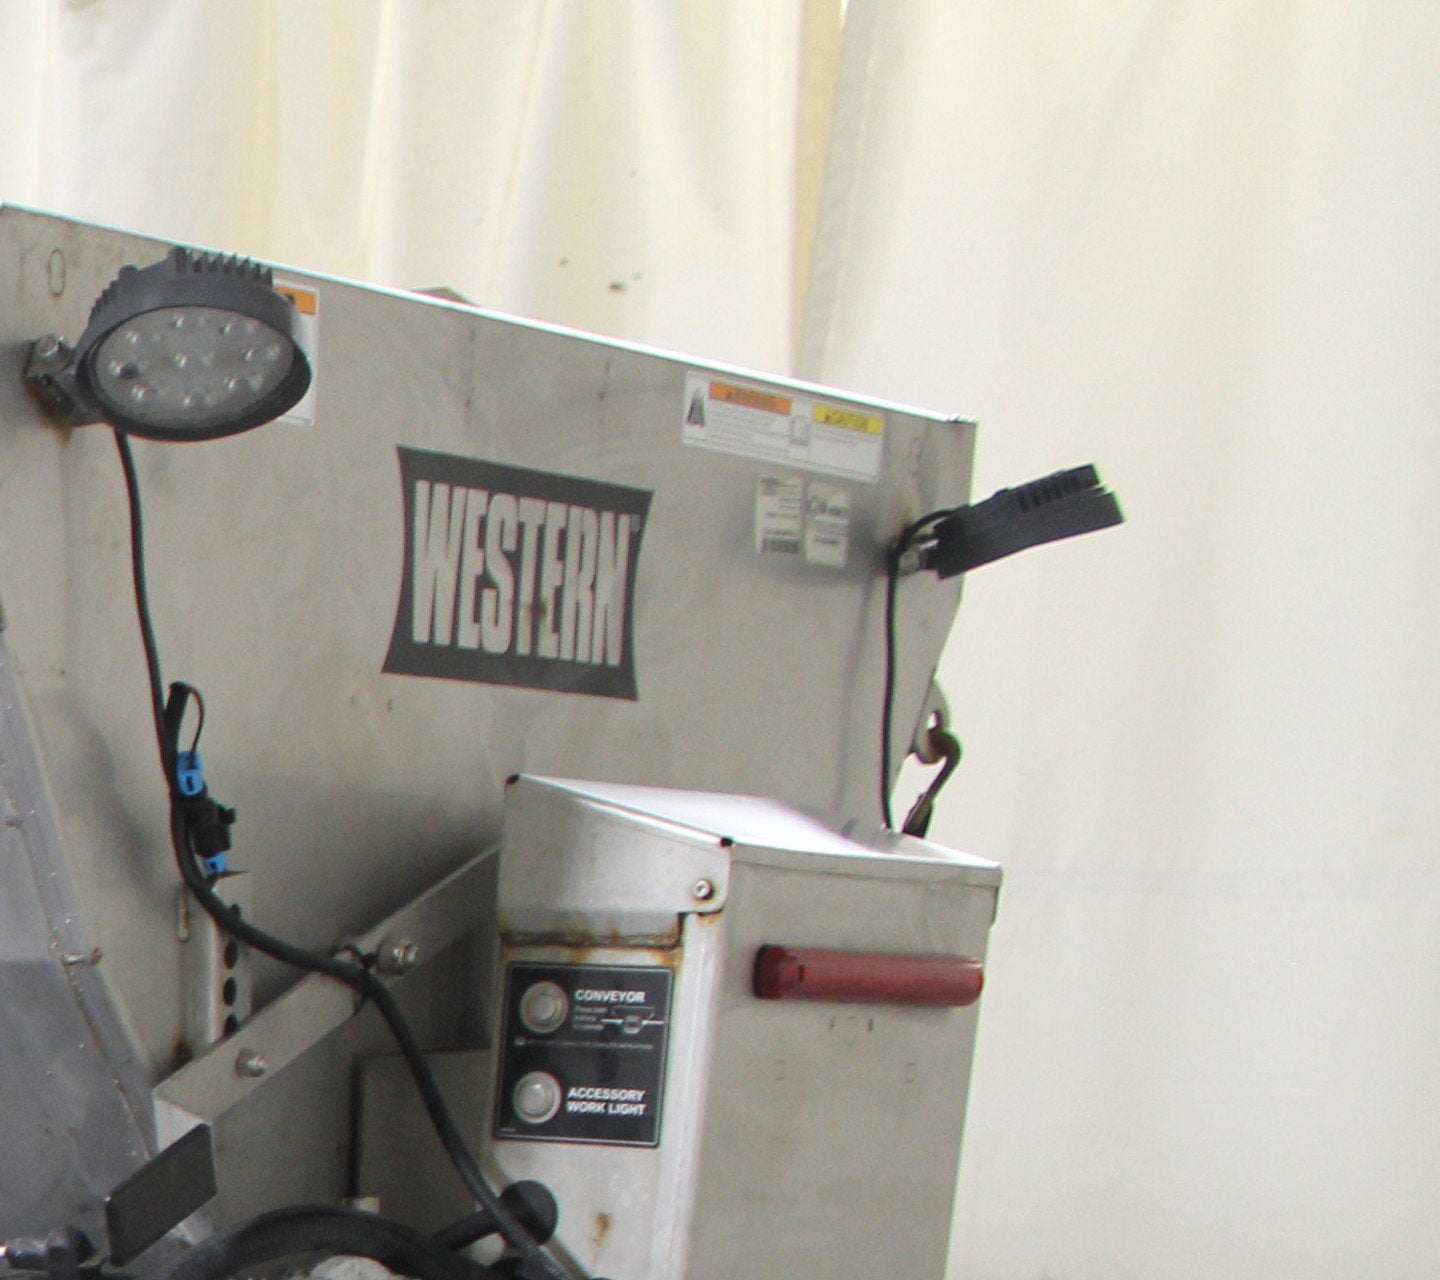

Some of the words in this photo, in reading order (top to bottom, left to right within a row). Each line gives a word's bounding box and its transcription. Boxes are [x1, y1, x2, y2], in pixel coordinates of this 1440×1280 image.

[413, 478, 631, 667] WESTERN
[575, 989, 646, 1003] CONVEYOR
[567, 1086, 646, 1101] ACCESSORY
[566, 1101, 606, 1114] WORK
[607, 1103, 647, 1116] LIGHT
